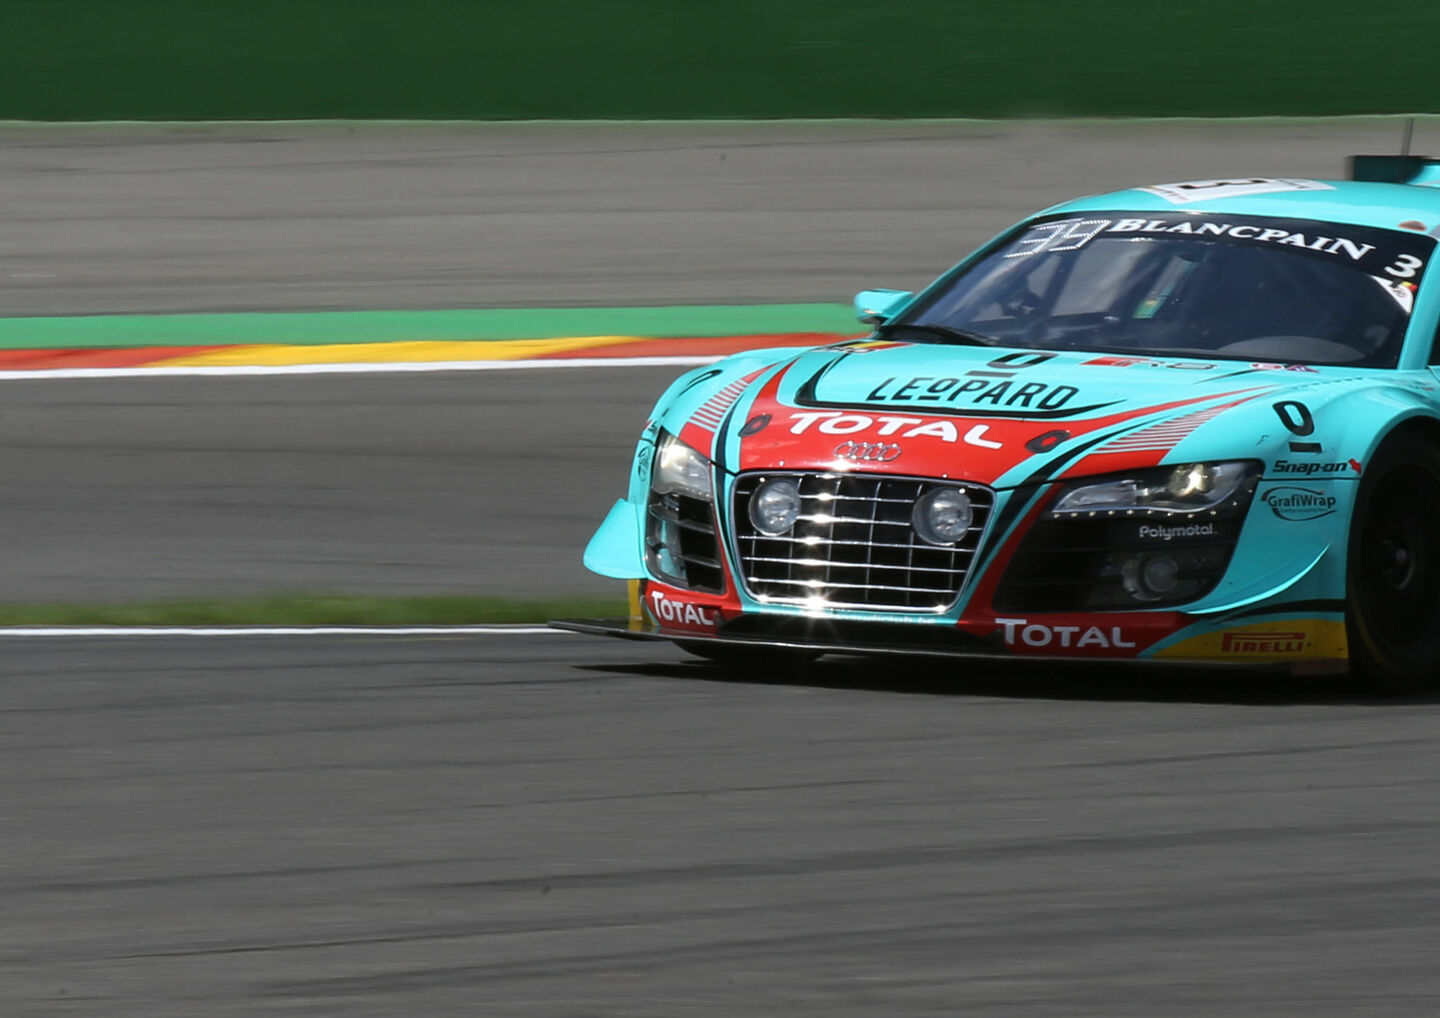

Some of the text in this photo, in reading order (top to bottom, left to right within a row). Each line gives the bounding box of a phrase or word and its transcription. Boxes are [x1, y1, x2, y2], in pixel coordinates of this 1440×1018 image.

[1105, 218, 1377, 261] BLANCPAIN
[1384, 254, 1423, 278] 3
[866, 377, 1079, 410] LEOPARD
[789, 411, 1003, 450] TOTAL
[1272, 460, 1348, 475] Snap-on
[1268, 493, 1337, 510] GrafiWrap
[651, 590, 714, 626] TOTAL
[994, 617, 1136, 648] TOTAL
[1221, 632, 1306, 653] PIRELLI
